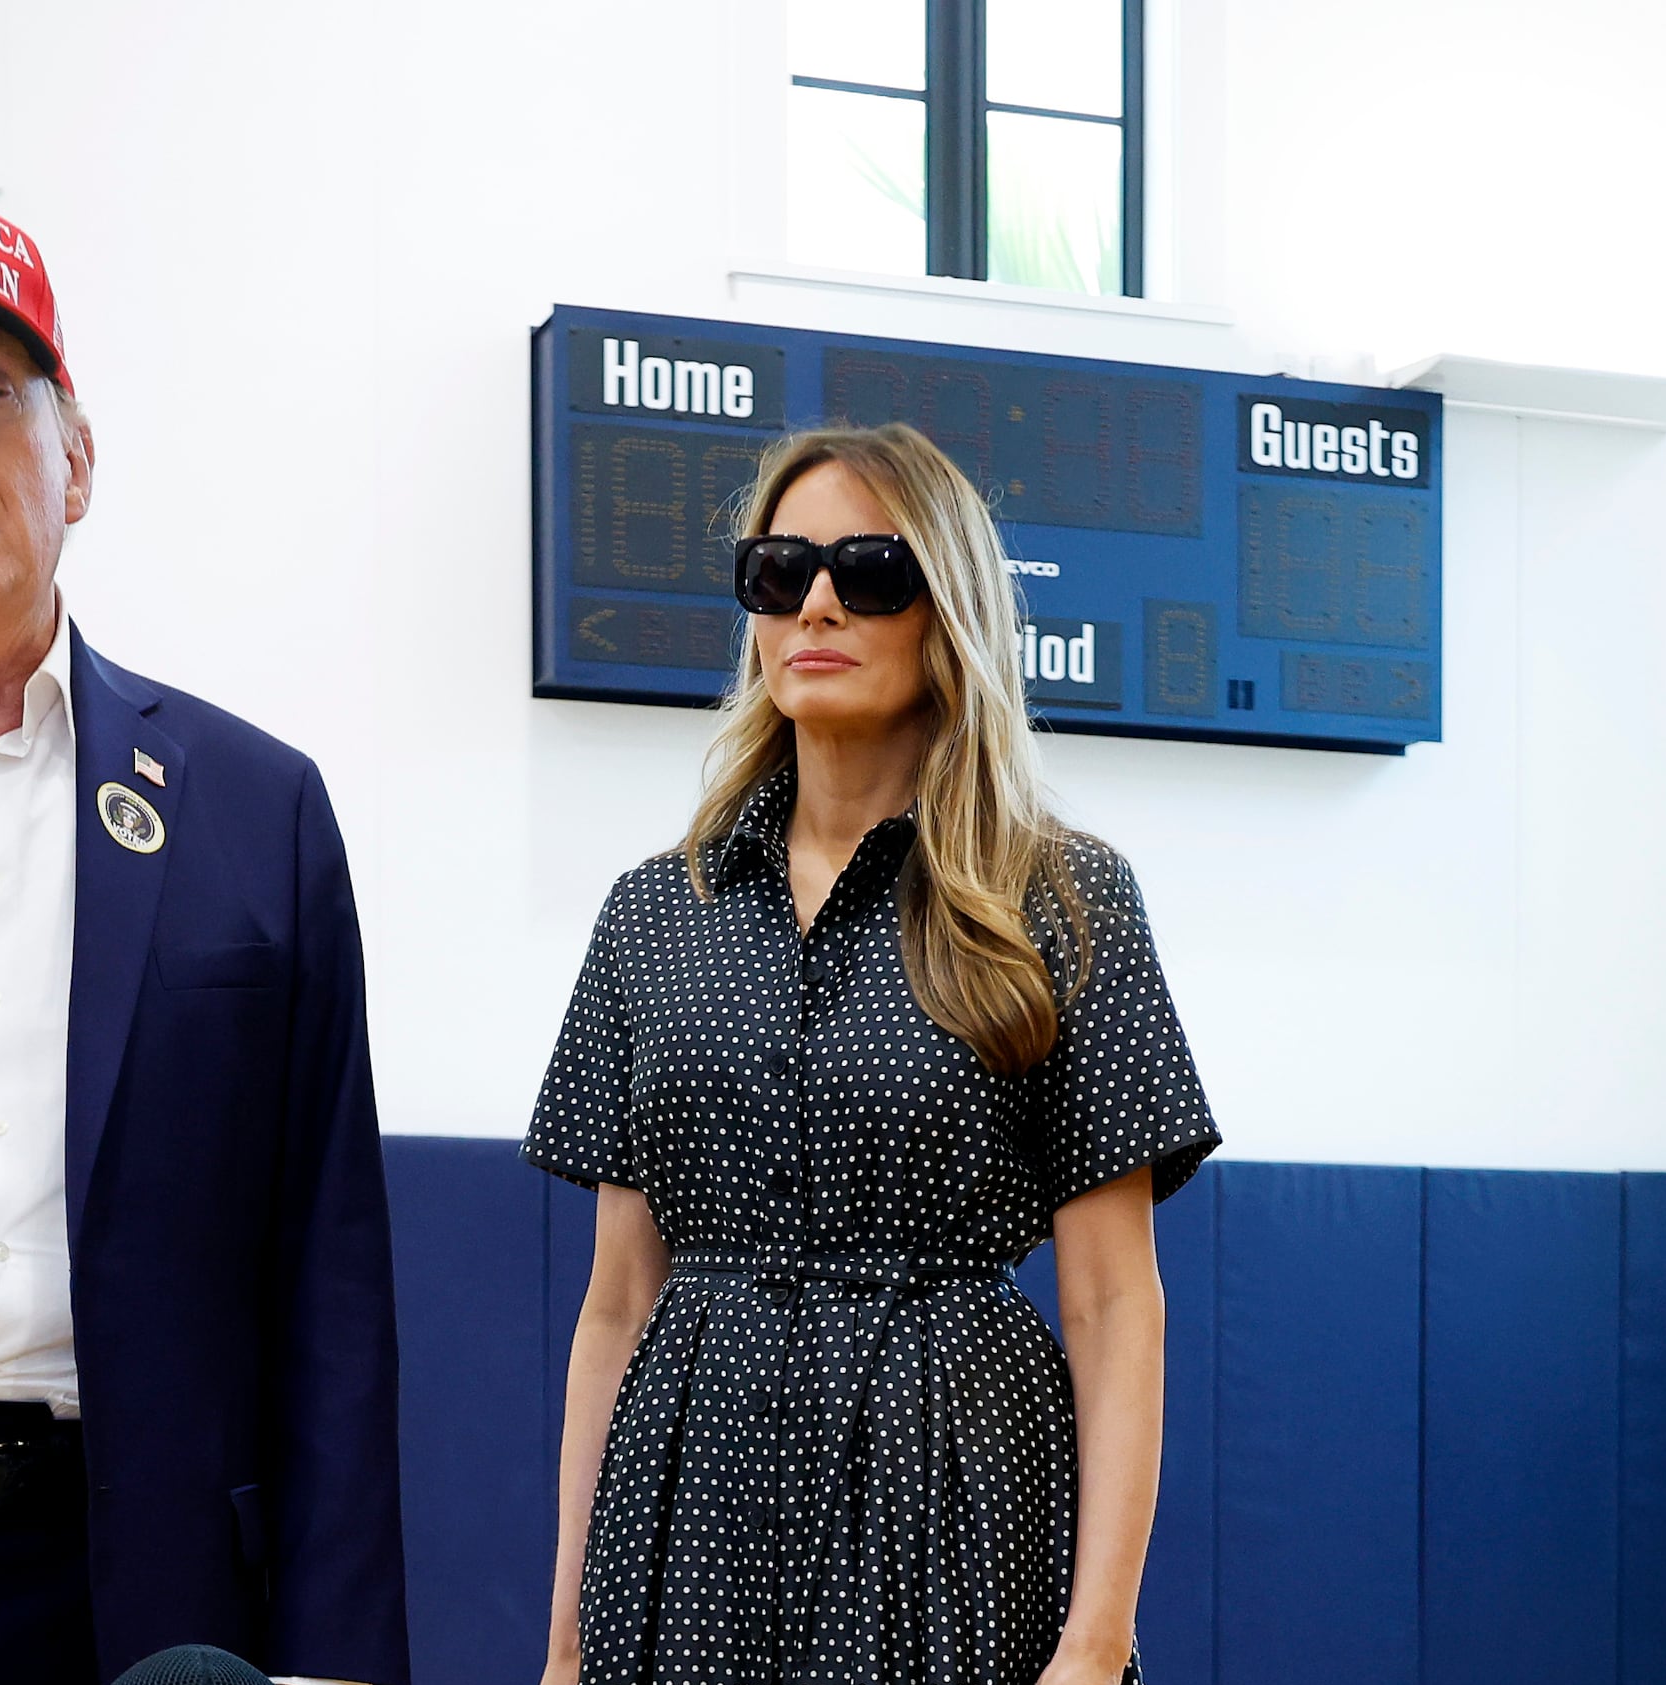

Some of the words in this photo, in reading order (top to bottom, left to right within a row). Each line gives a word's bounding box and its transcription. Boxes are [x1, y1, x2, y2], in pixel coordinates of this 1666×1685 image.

[603, 338, 754, 418] Home
[1251, 403, 1419, 479] Guests
[1003, 559, 1060, 578] EVCO
